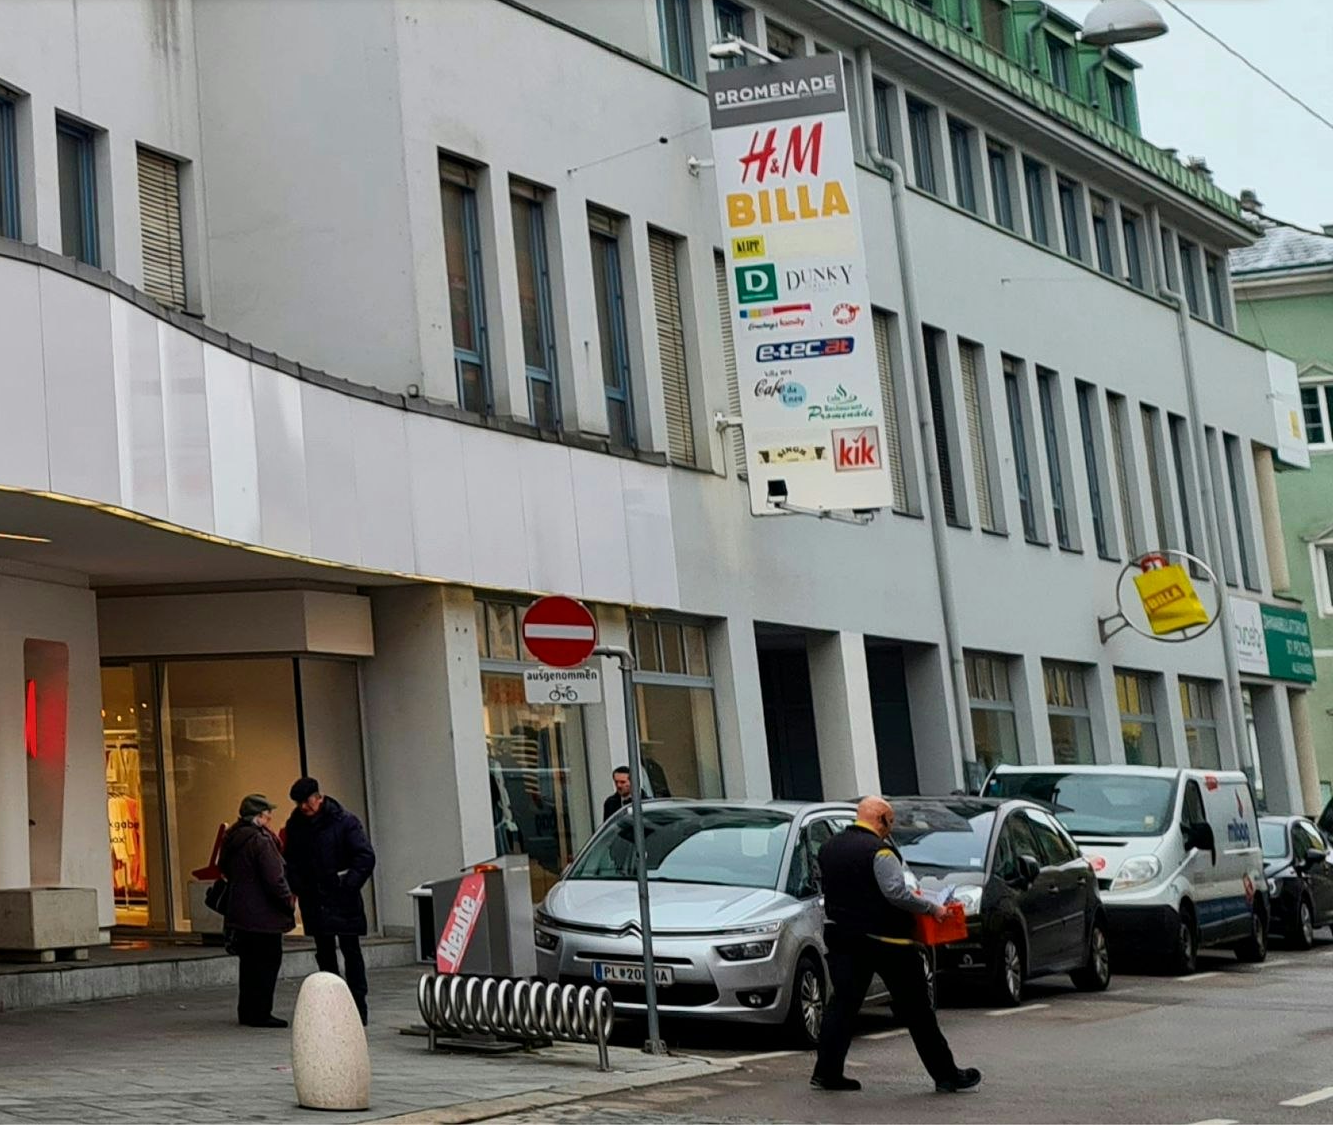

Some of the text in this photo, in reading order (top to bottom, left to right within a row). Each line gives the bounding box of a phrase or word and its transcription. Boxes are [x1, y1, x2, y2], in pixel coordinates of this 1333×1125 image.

[714, 75, 837, 106] PROMENADE
[738, 121, 823, 185] H&M
[726, 181, 850, 229] BILLA
[786, 264, 853, 291] DUNKY
[807, 404, 874, 421] Promenade
[839, 429, 875, 467] kik
[1146, 586, 1184, 608] BILLA
[526, 667, 598, 683] ausgenommen
[438, 891, 477, 966] Heute
[604, 966, 619, 979] PL
